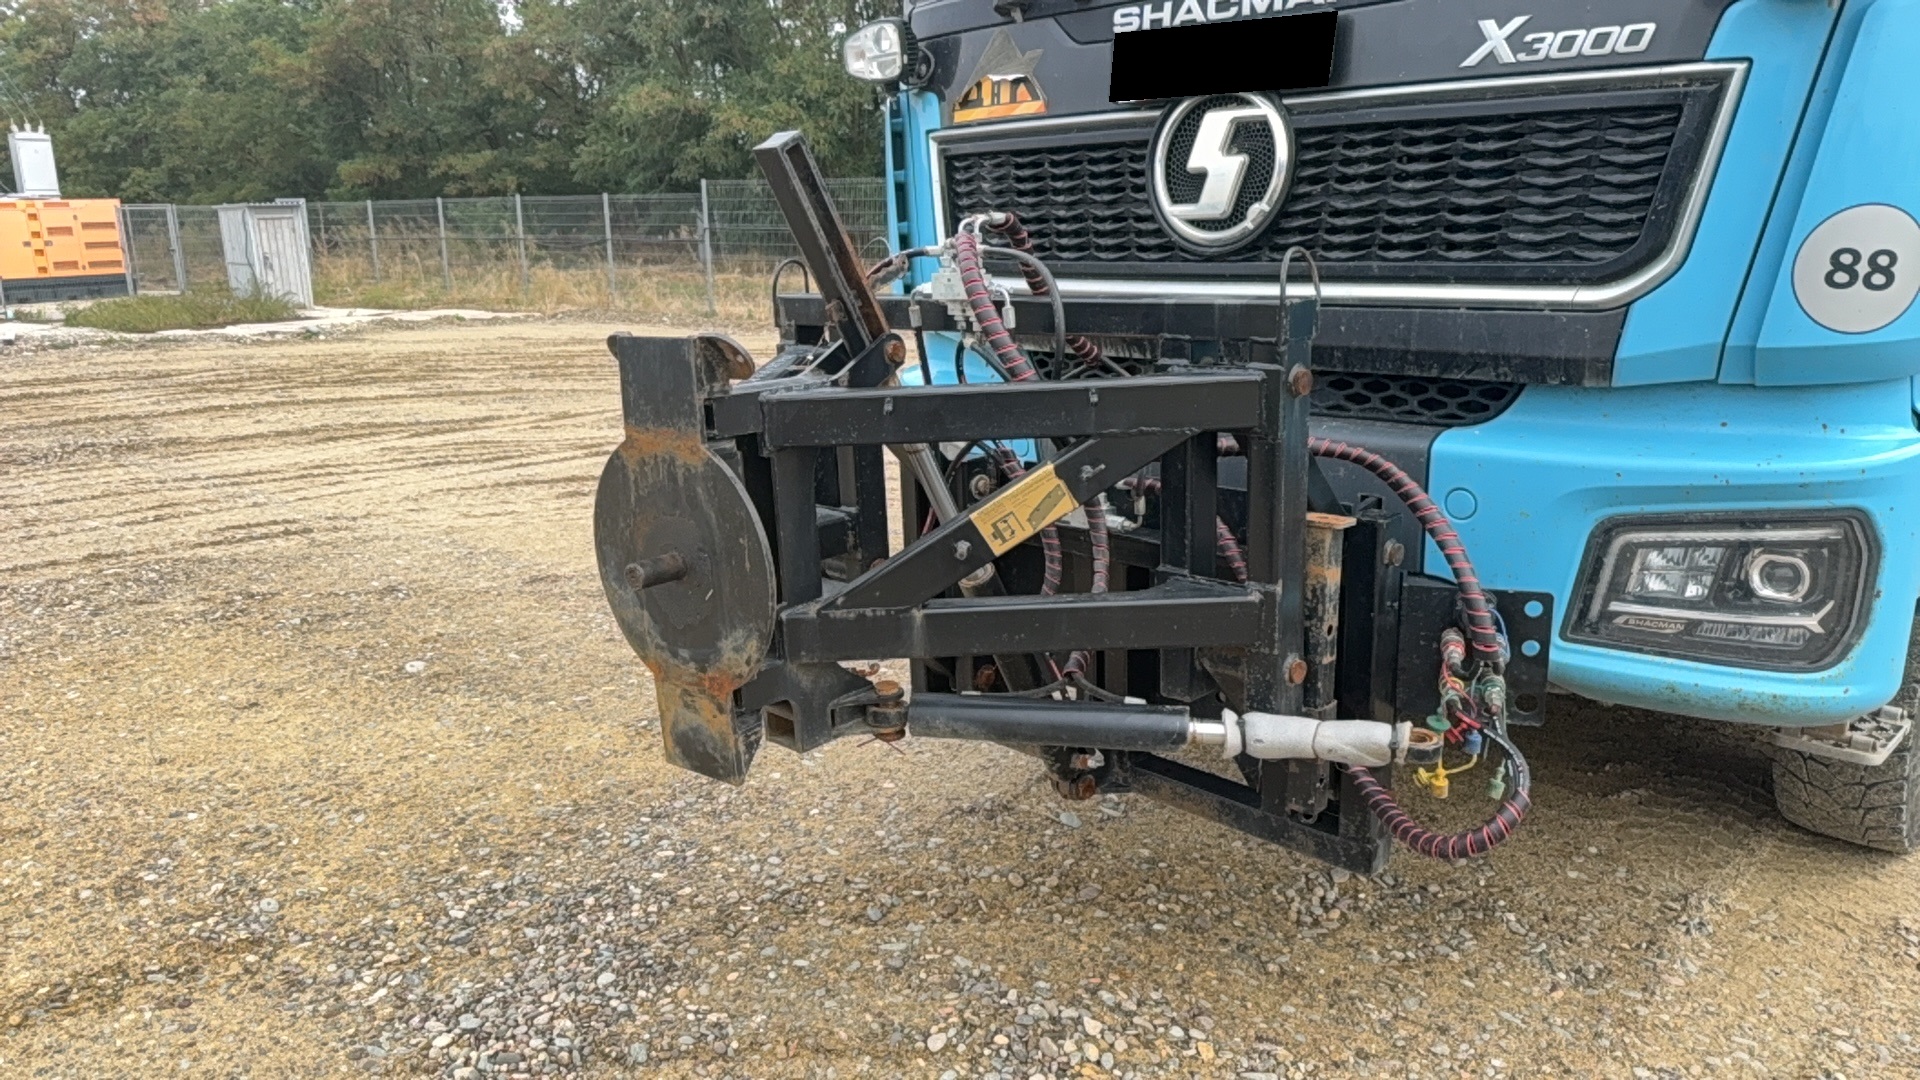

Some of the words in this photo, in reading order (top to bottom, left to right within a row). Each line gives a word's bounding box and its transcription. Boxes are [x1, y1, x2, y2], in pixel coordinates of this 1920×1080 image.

[1113, 0, 1337, 33] SHACM
[1458, 14, 1657, 68] X3000
[1823, 247, 1898, 291] 88
[1627, 618, 1685, 631] SHACMAN
